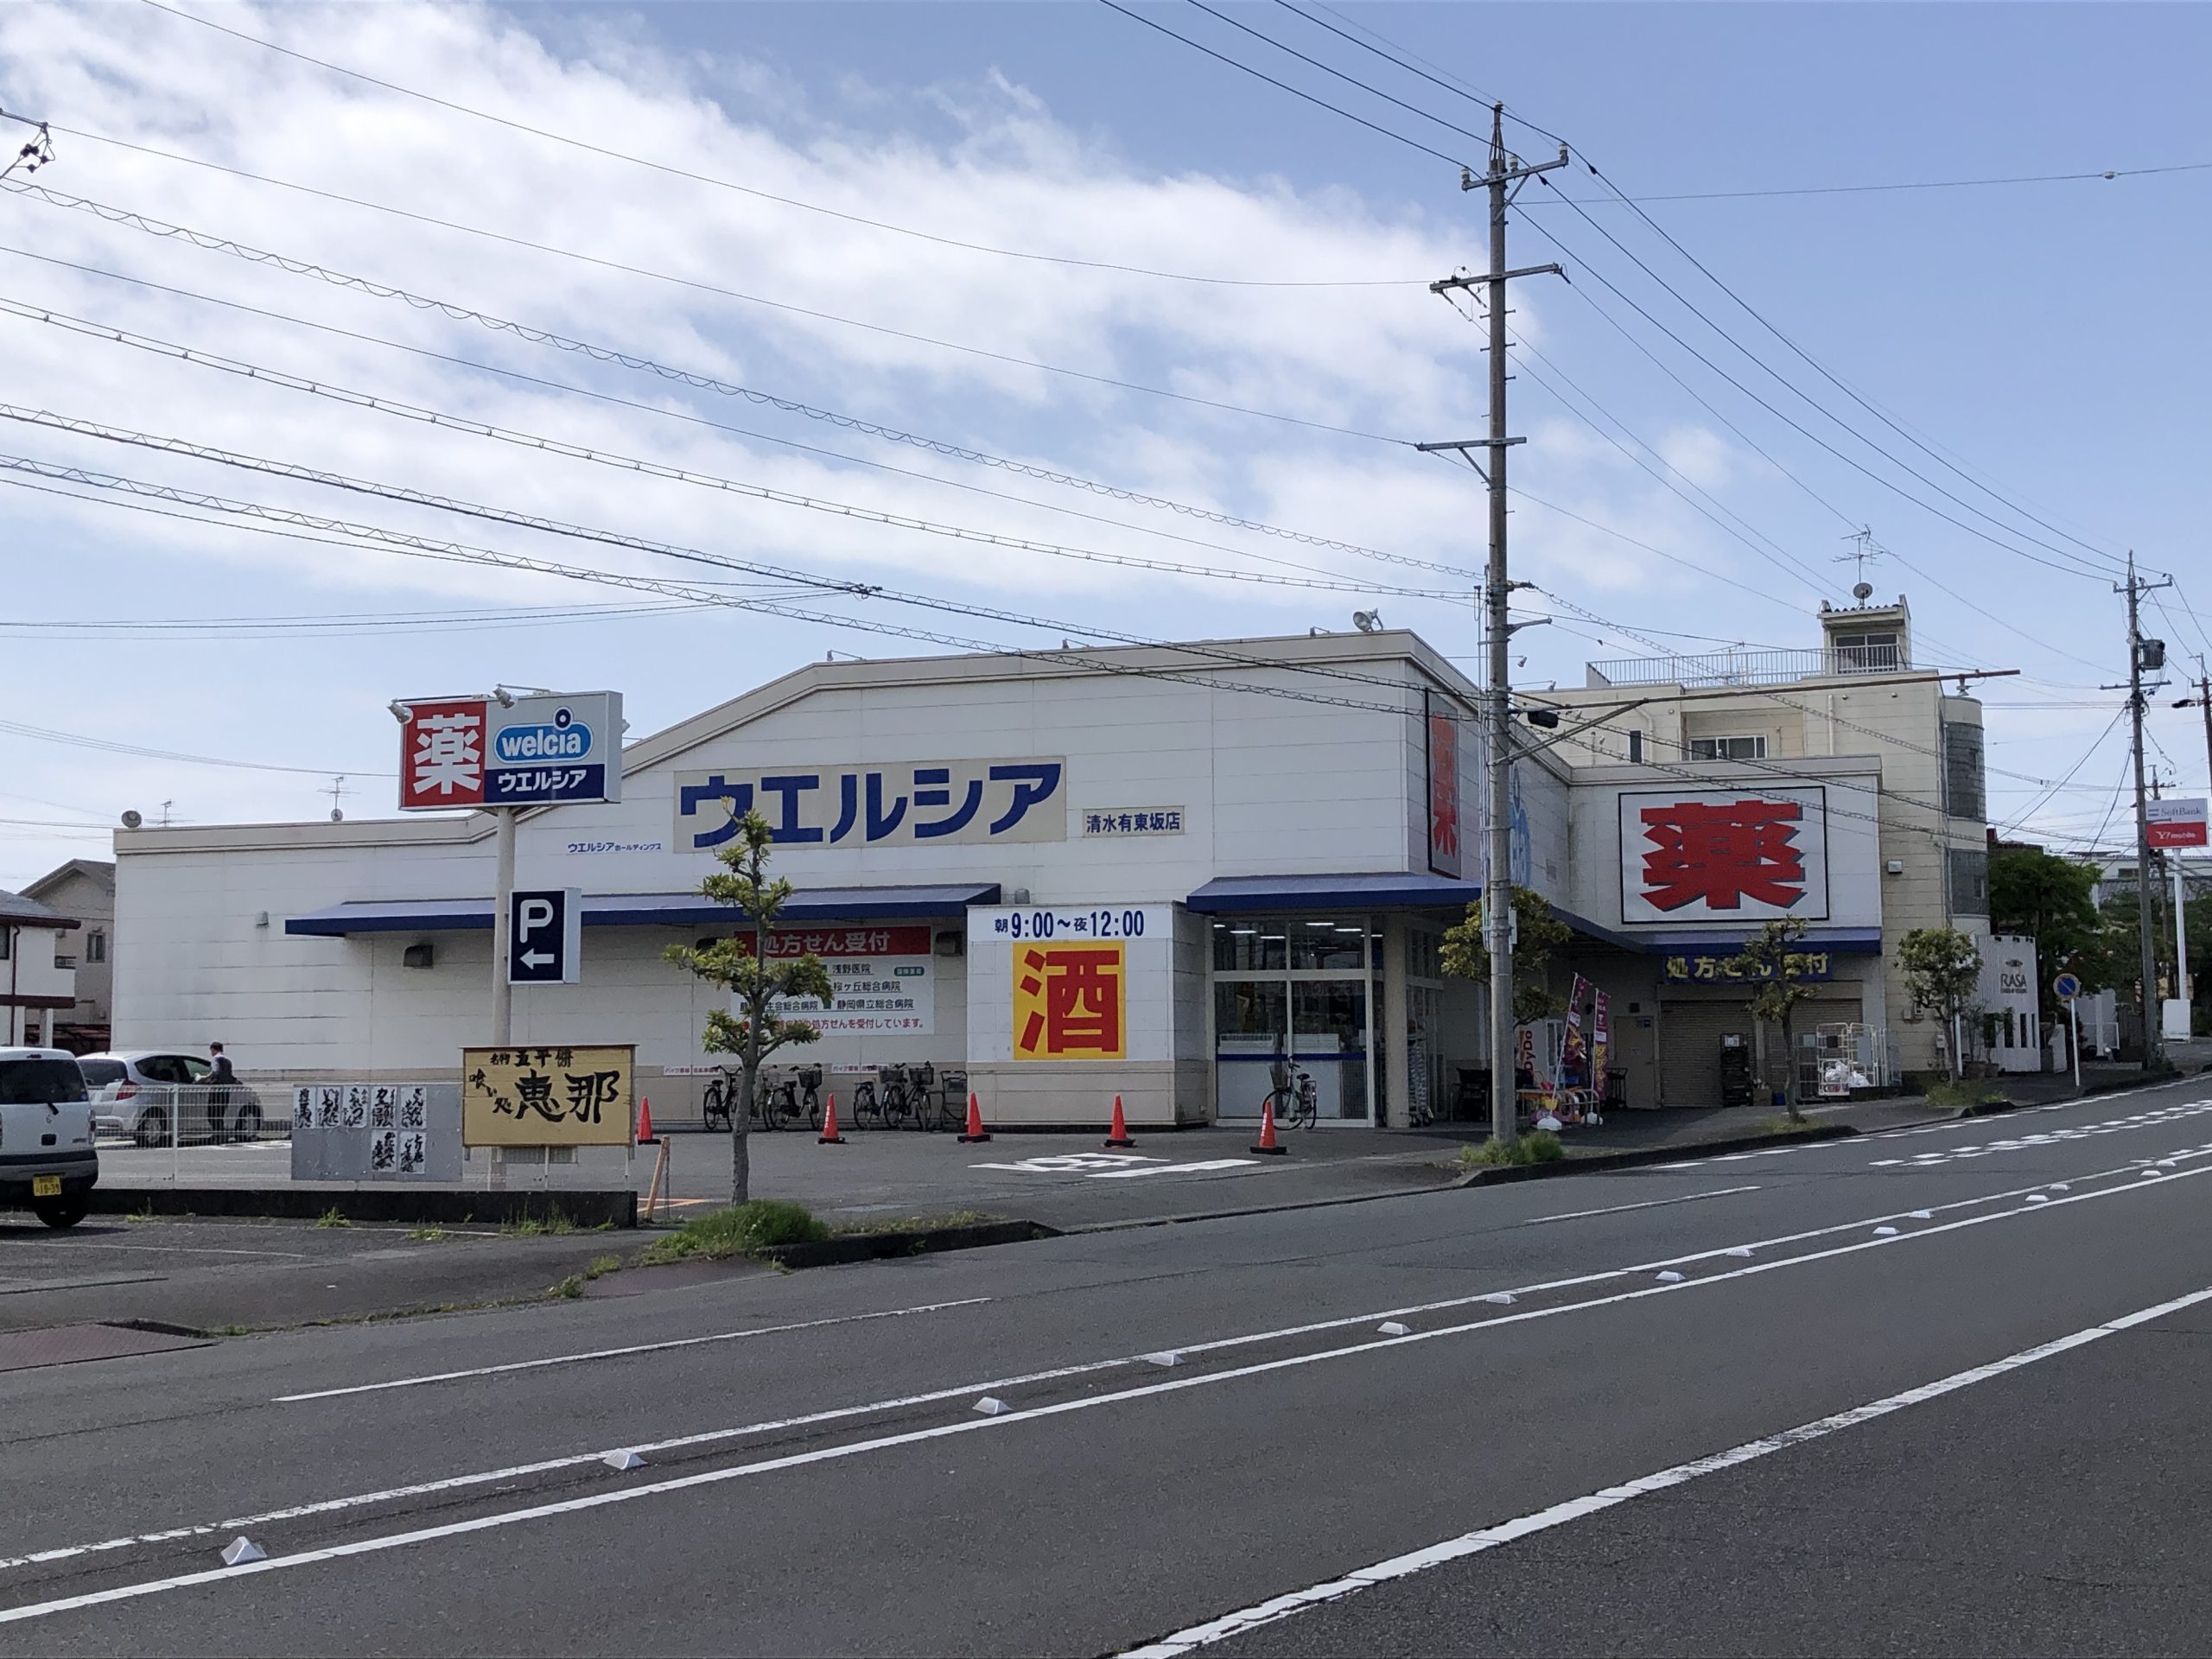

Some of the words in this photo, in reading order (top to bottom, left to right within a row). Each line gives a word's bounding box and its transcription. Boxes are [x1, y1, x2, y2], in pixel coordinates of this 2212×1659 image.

[413, 713, 481, 795] 薬
[501, 707, 582, 757] welcia
[498, 769, 587, 793] ウエルシア
[680, 763, 1062, 849] ウエルシア
[1086, 811, 1180, 833] 清水有東坂店
[2161, 807, 2202, 817] SoftBank
[1639, 799, 1808, 912] 薬
[519, 899, 554, 944] P
[1020, 949, 1120, 1053] 酒
[2000, 973, 2027, 987] RASA
[836, 999, 914, 1010] 静岡県立総合病院
[1523, 1030, 1535, 1072] DyDo
[514, 1068, 620, 1124] 恵那
